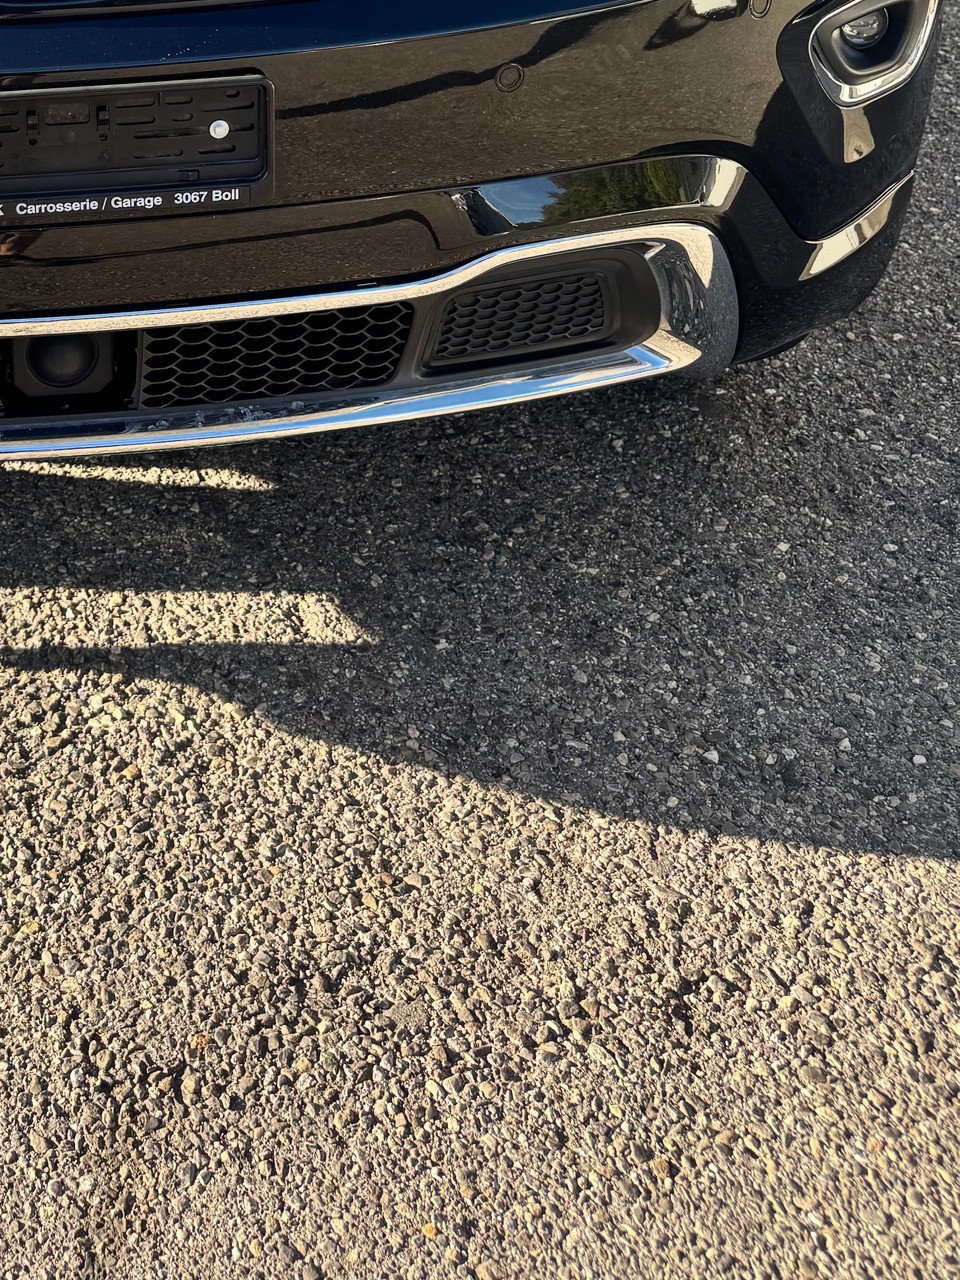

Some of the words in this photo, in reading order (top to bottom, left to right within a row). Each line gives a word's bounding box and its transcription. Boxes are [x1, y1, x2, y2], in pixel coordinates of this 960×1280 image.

[15, 198, 99, 215] Carrosserie
[110, 195, 163, 209] Garage
[174, 191, 208, 205] 3067
[211, 188, 239, 202] Boll
